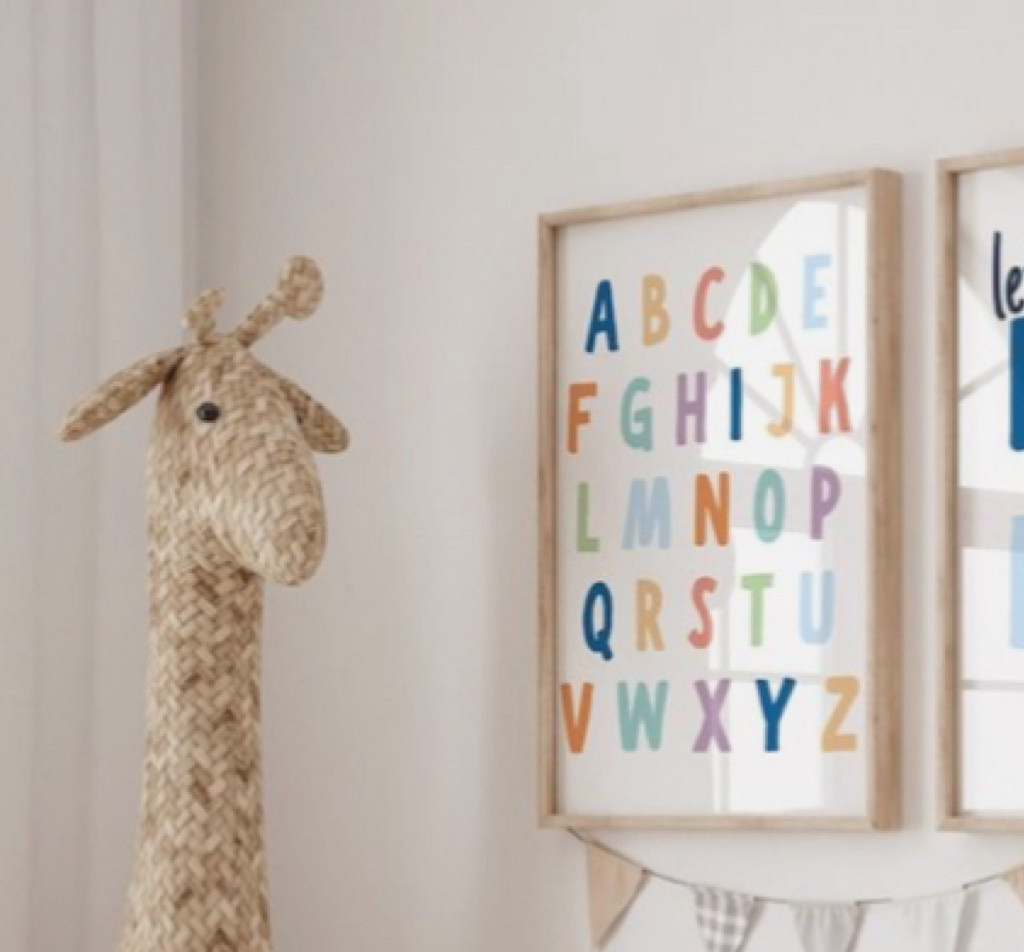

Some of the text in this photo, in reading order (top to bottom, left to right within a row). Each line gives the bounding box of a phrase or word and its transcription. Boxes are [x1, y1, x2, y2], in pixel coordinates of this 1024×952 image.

[585, 254, 832, 354] A B C D E
[566, 356, 852, 454] F G H I J K
[576, 465, 841, 553] L M N O P
[582, 570, 835, 661] Q R S T U
[561, 676, 860, 753] V W X Y Z
